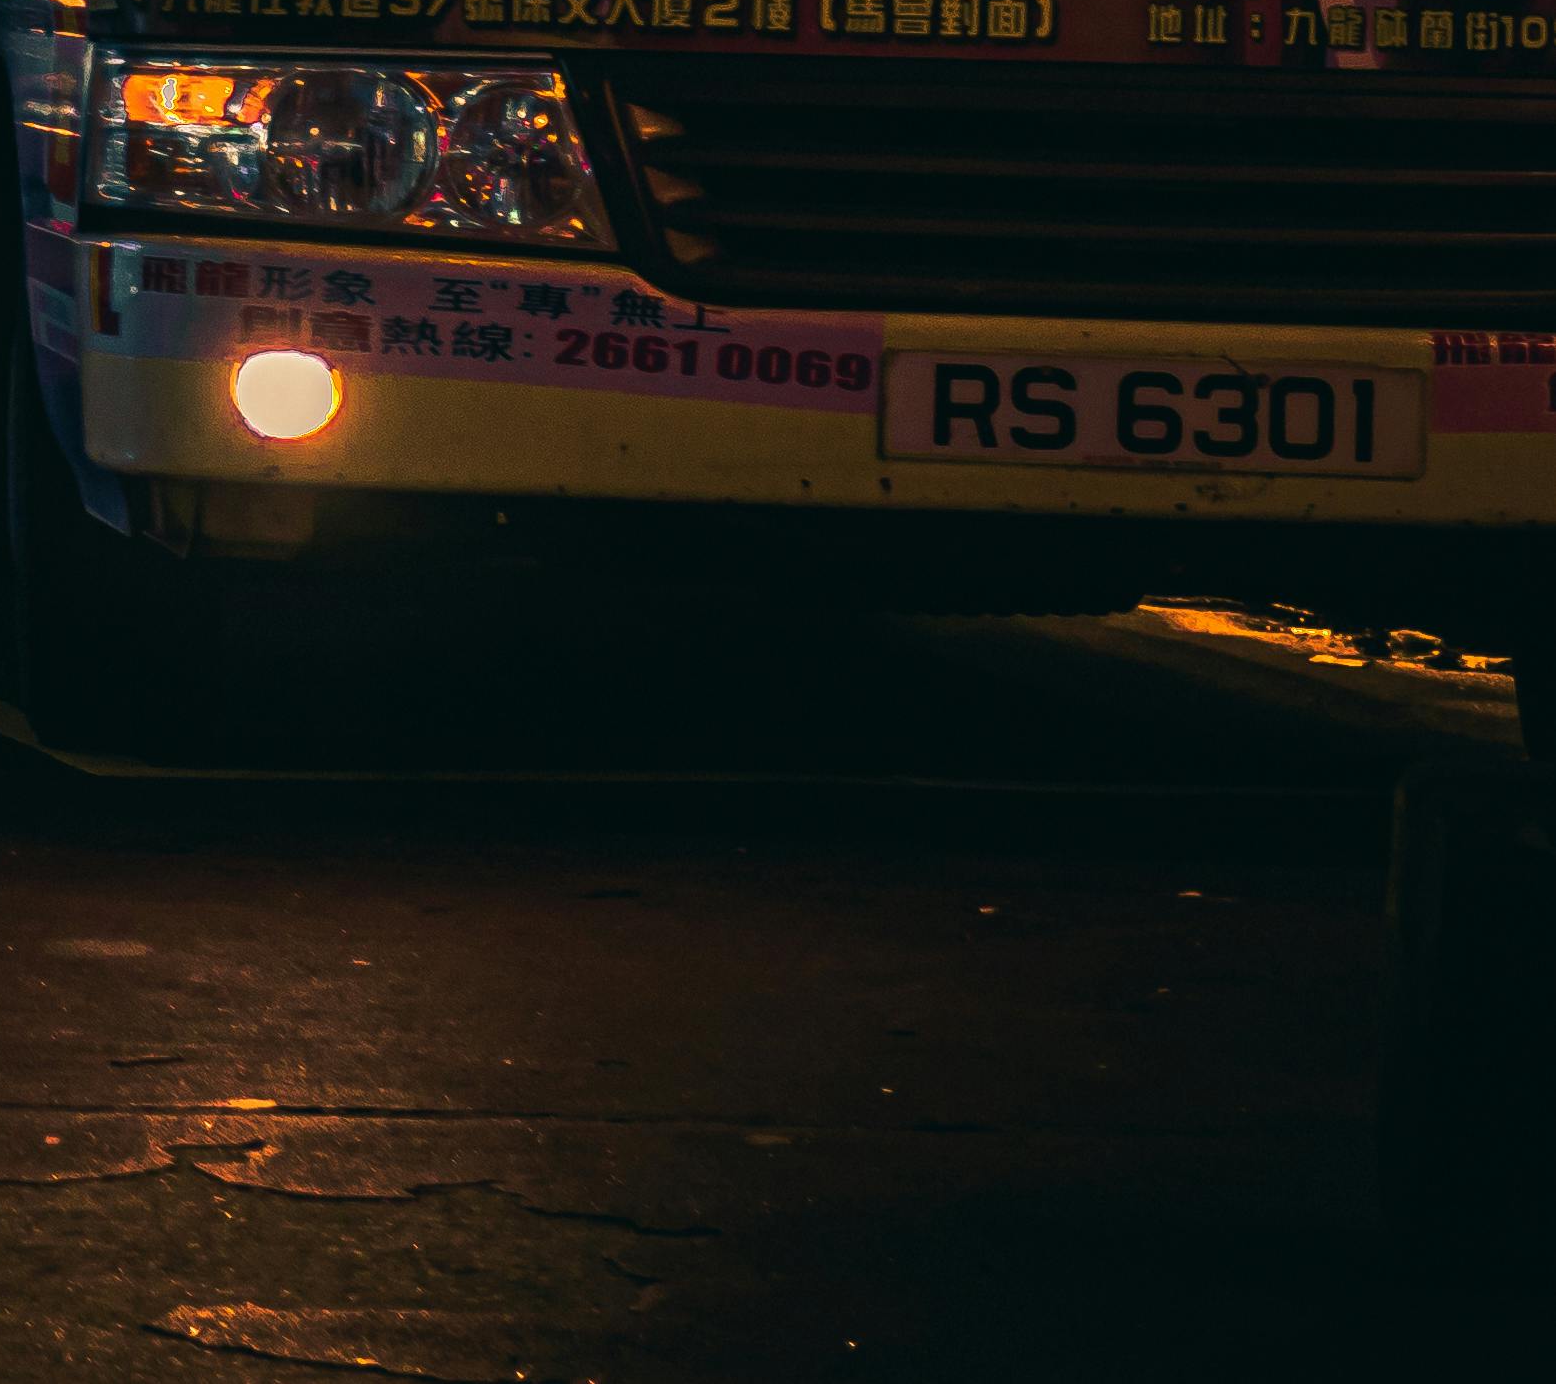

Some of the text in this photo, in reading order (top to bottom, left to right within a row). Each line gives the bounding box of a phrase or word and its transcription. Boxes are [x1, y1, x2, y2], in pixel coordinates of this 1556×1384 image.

[1146, 2, 1556, 53] 地址:九龍砵蘭街10
[553, 327, 696, 379] 2661
[717, 339, 874, 393] 0069
[932, 362, 1376, 464] RS 6301
